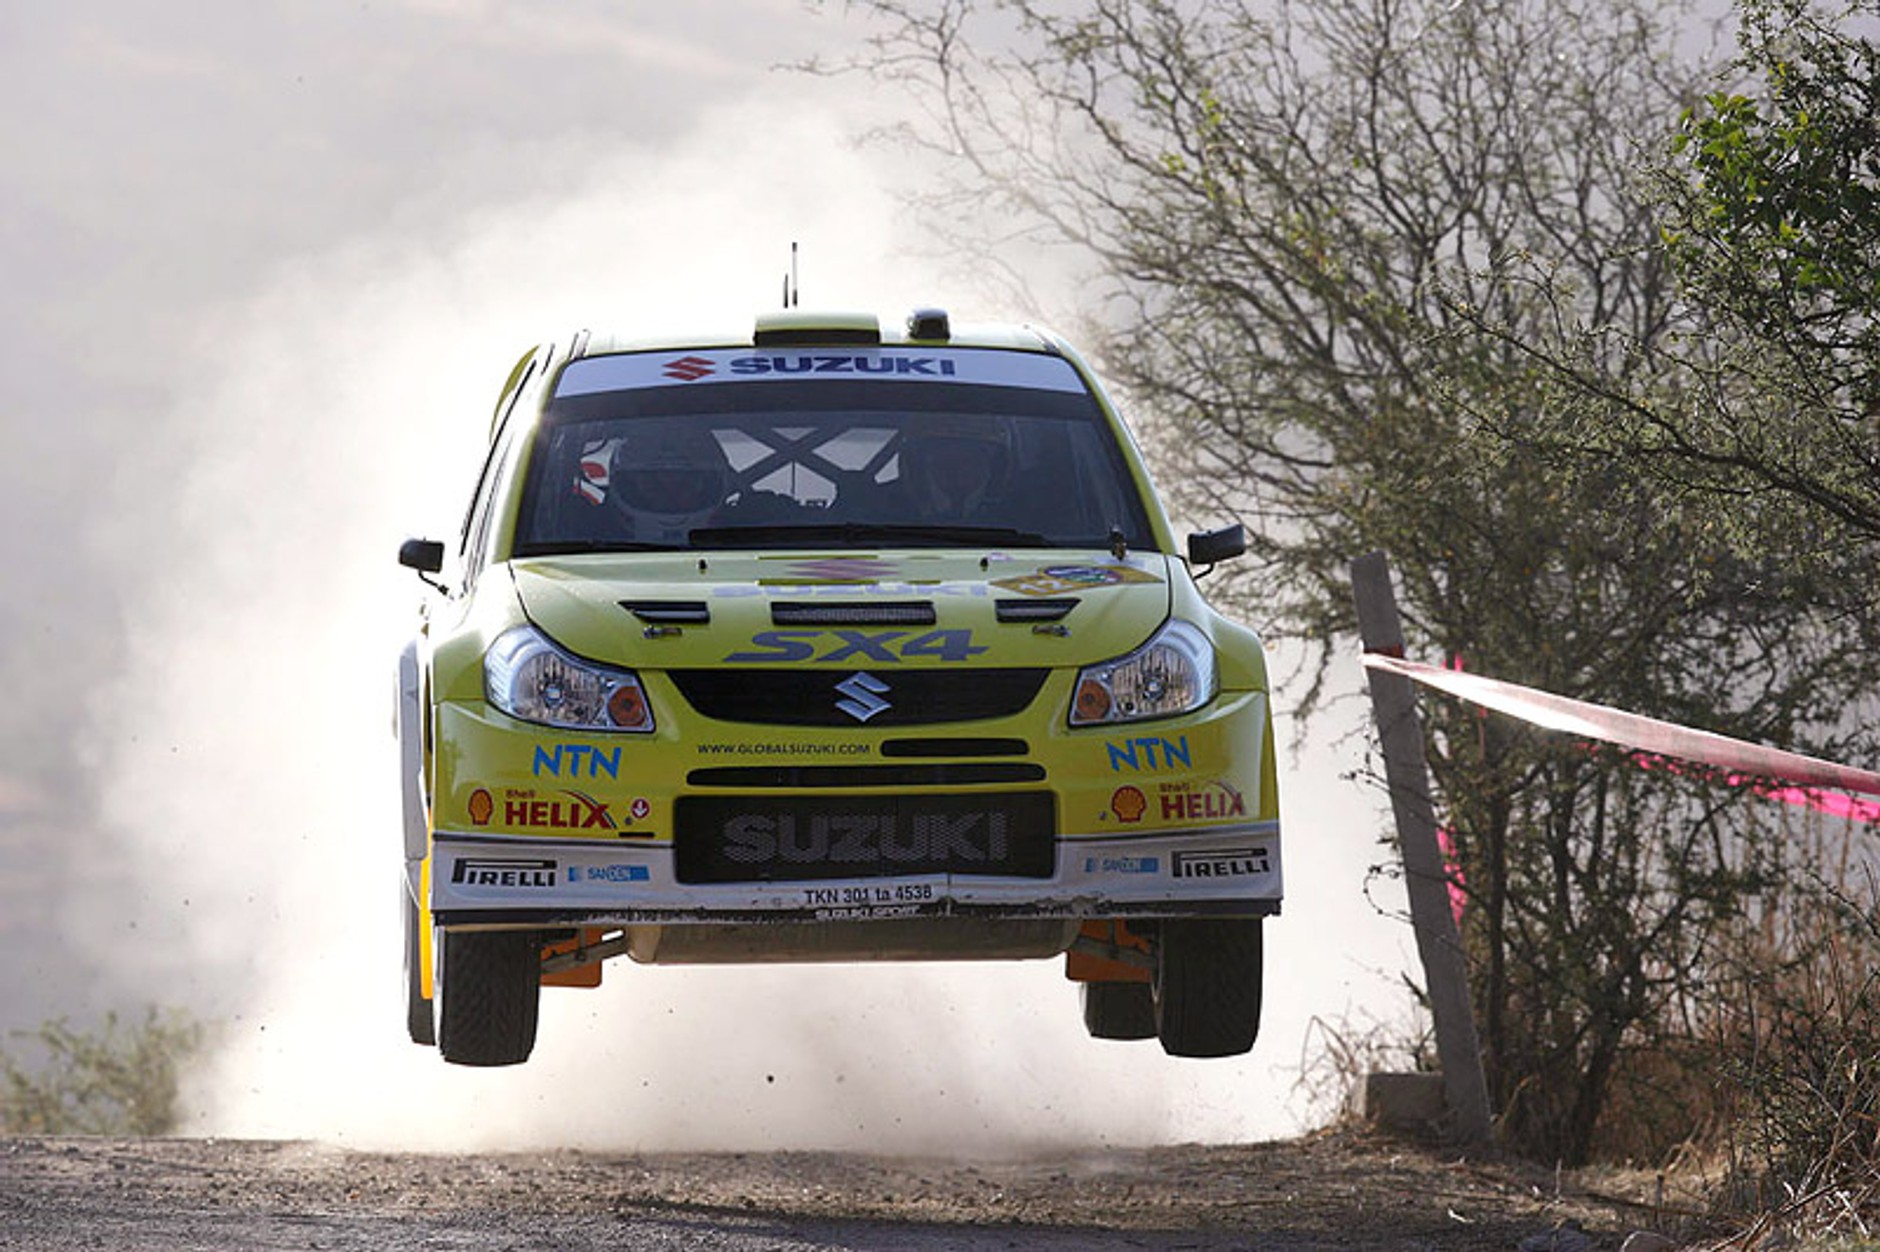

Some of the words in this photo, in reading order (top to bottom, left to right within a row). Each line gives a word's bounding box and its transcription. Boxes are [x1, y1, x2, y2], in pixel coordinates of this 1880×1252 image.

[729, 355, 956, 377] SUZUKI
[722, 629, 990, 662] SX4
[532, 744, 622, 779] NTN
[697, 743, 871, 755] WWW.GLOBALSUZUKI.COM
[1105, 735, 1192, 772] NTN
[505, 788, 536, 799] Shell
[1160, 792, 1246, 820] HELIX
[504, 801, 614, 829] HELIX
[722, 811, 1008, 864] SUZUKI
[451, 858, 558, 887] PIRELLI
[1171, 847, 1270, 878] PIRELLI
[803, 888, 839, 904] TKN
[843, 887, 869, 903] 301
[895, 883, 933, 901] 4538
